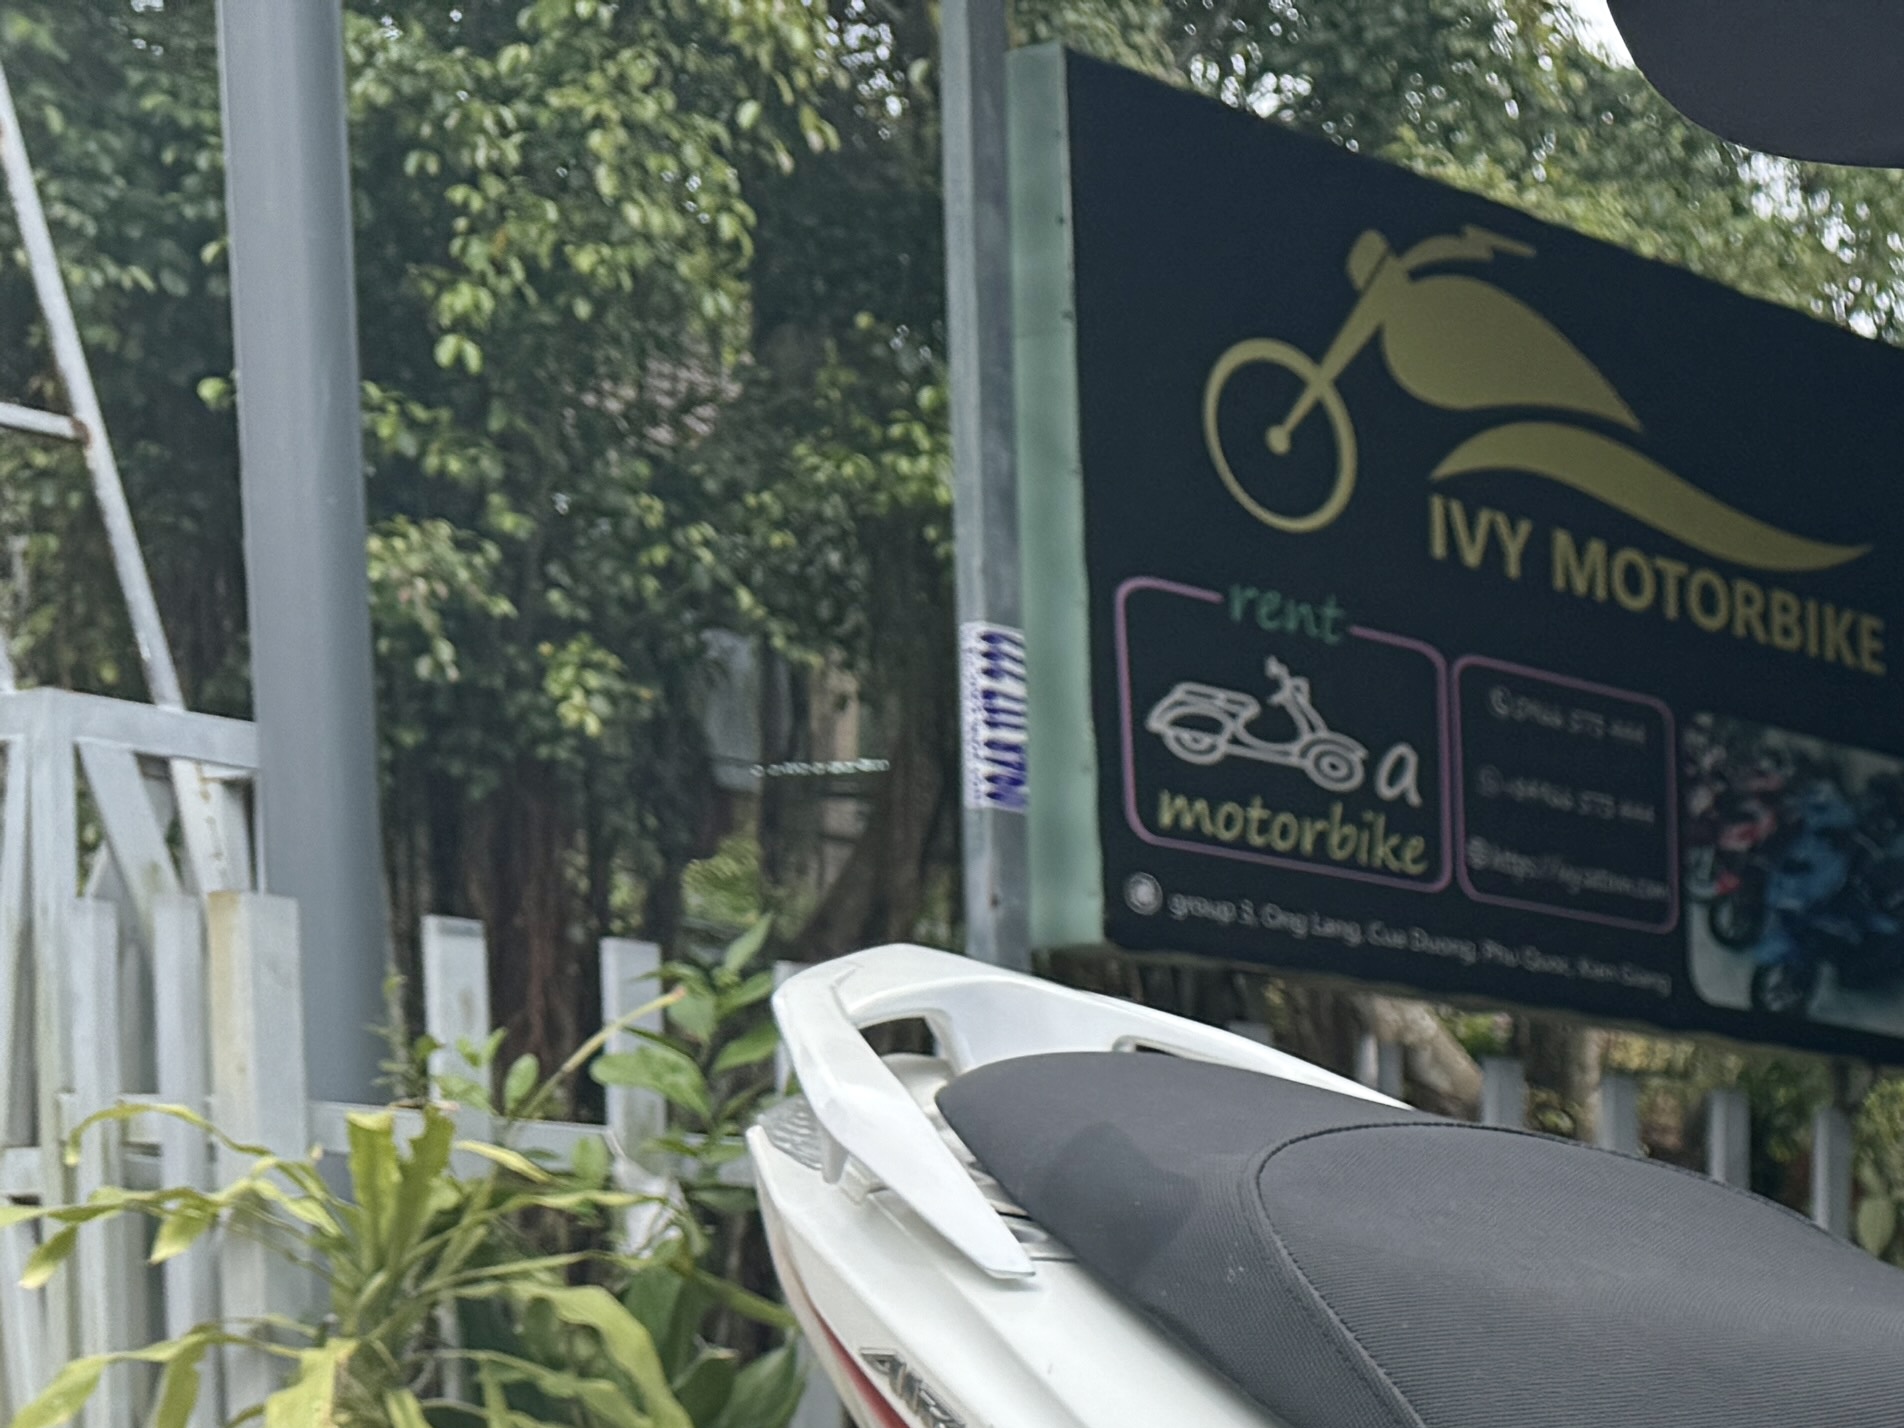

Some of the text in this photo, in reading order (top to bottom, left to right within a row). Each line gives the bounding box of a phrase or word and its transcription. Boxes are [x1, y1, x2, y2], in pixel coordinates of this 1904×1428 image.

[1228, 584, 1345, 645] rent
[1428, 494, 1886, 675] IVY MOTORBIKE
[1374, 742, 1423, 807] a
[1157, 789, 1429, 875] motorbike
